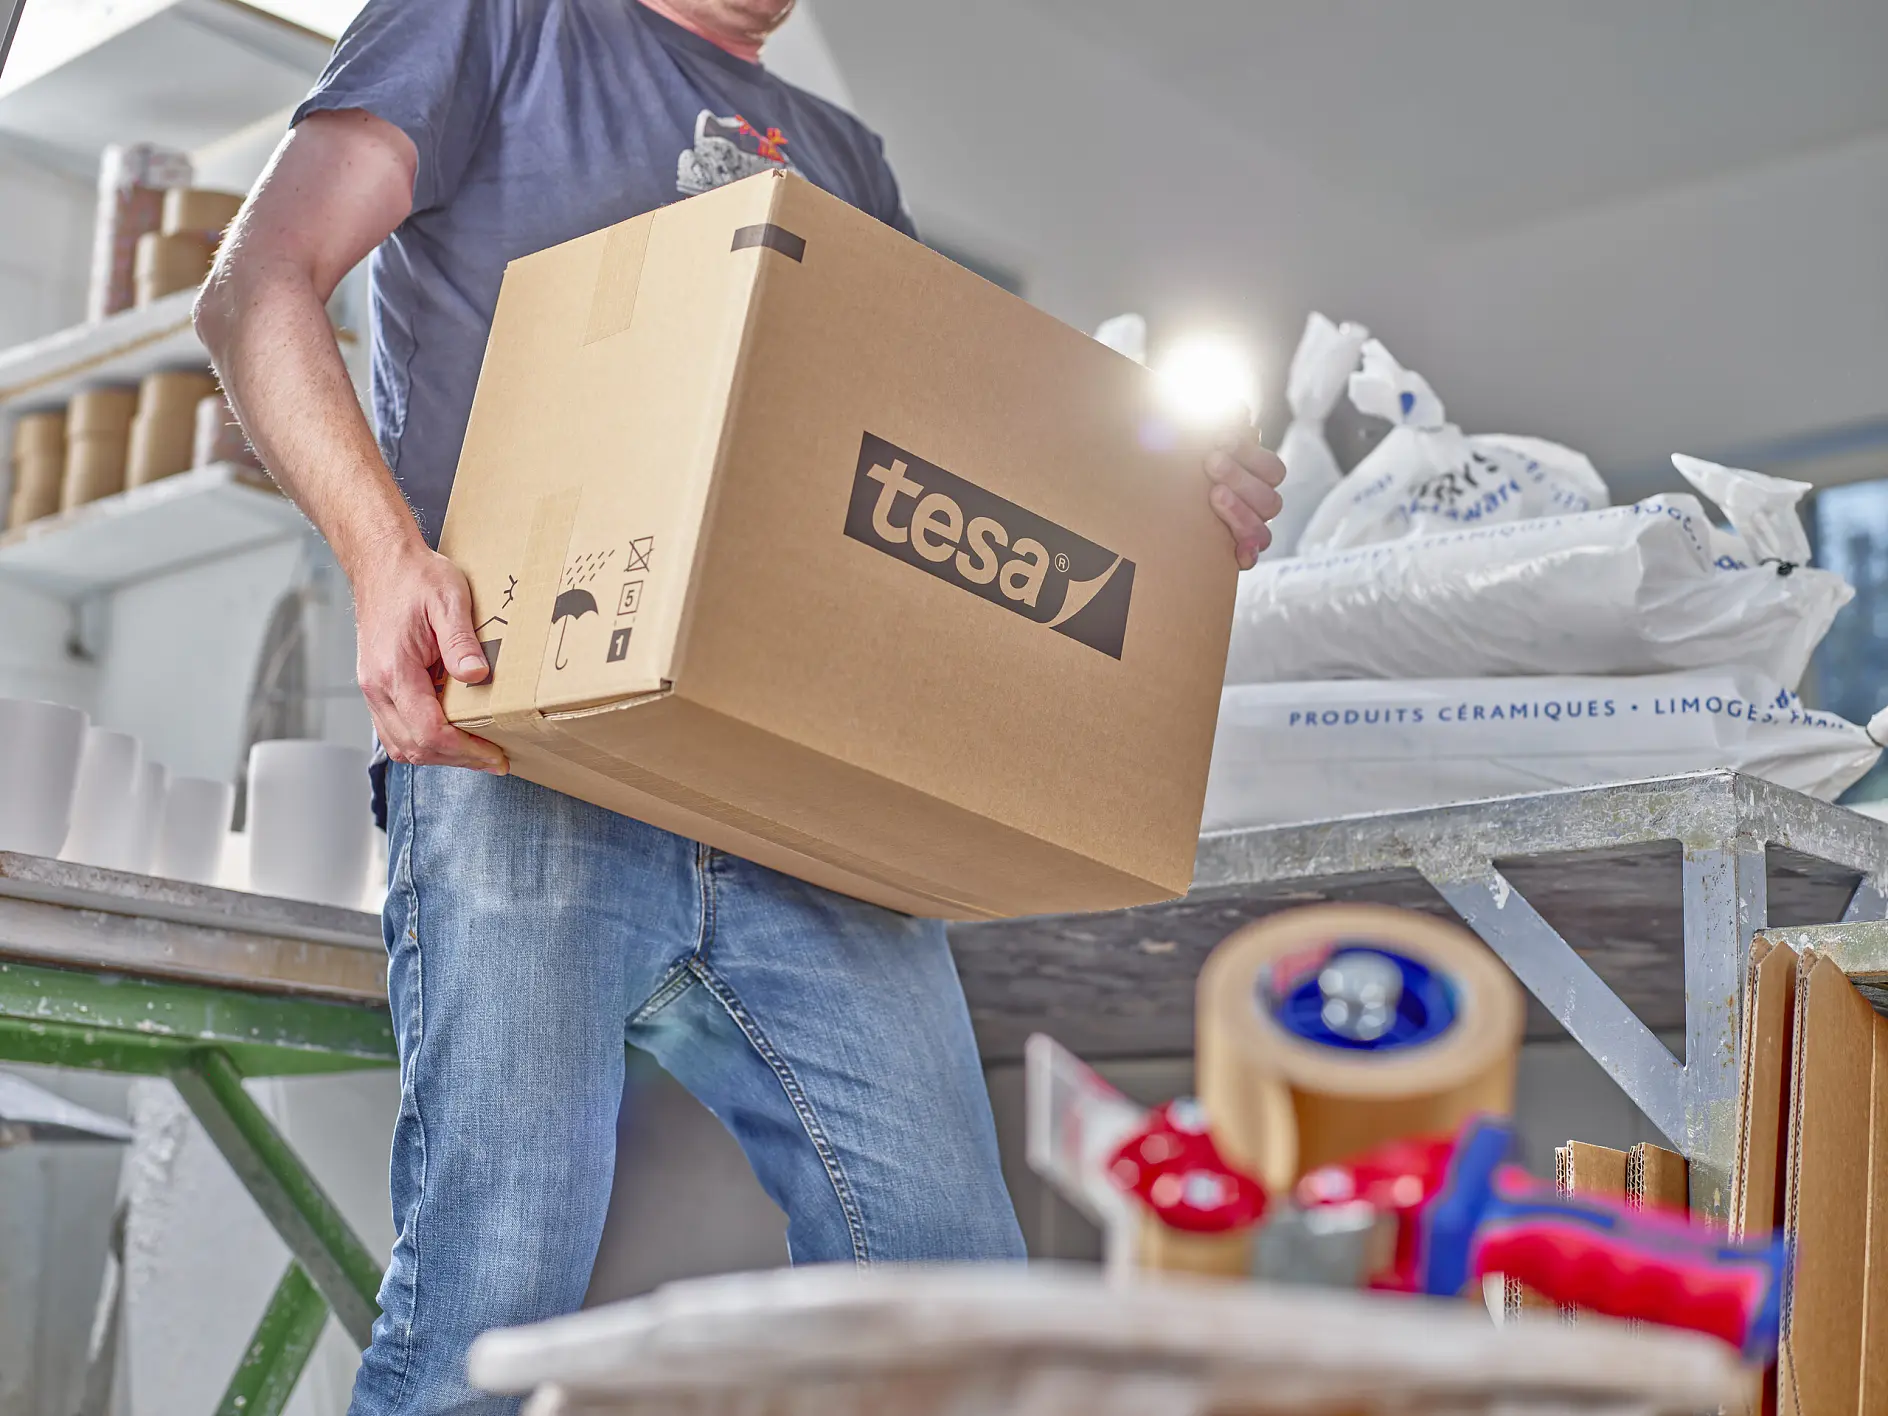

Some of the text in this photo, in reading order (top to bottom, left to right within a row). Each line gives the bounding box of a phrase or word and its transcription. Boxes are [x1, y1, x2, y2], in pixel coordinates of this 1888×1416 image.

[625, 590, 634, 607] 5
[615, 635, 624, 656] 1
[1289, 707, 1424, 727] PRODUITS
[1438, 699, 1616, 722] CÉRAMIQUES
